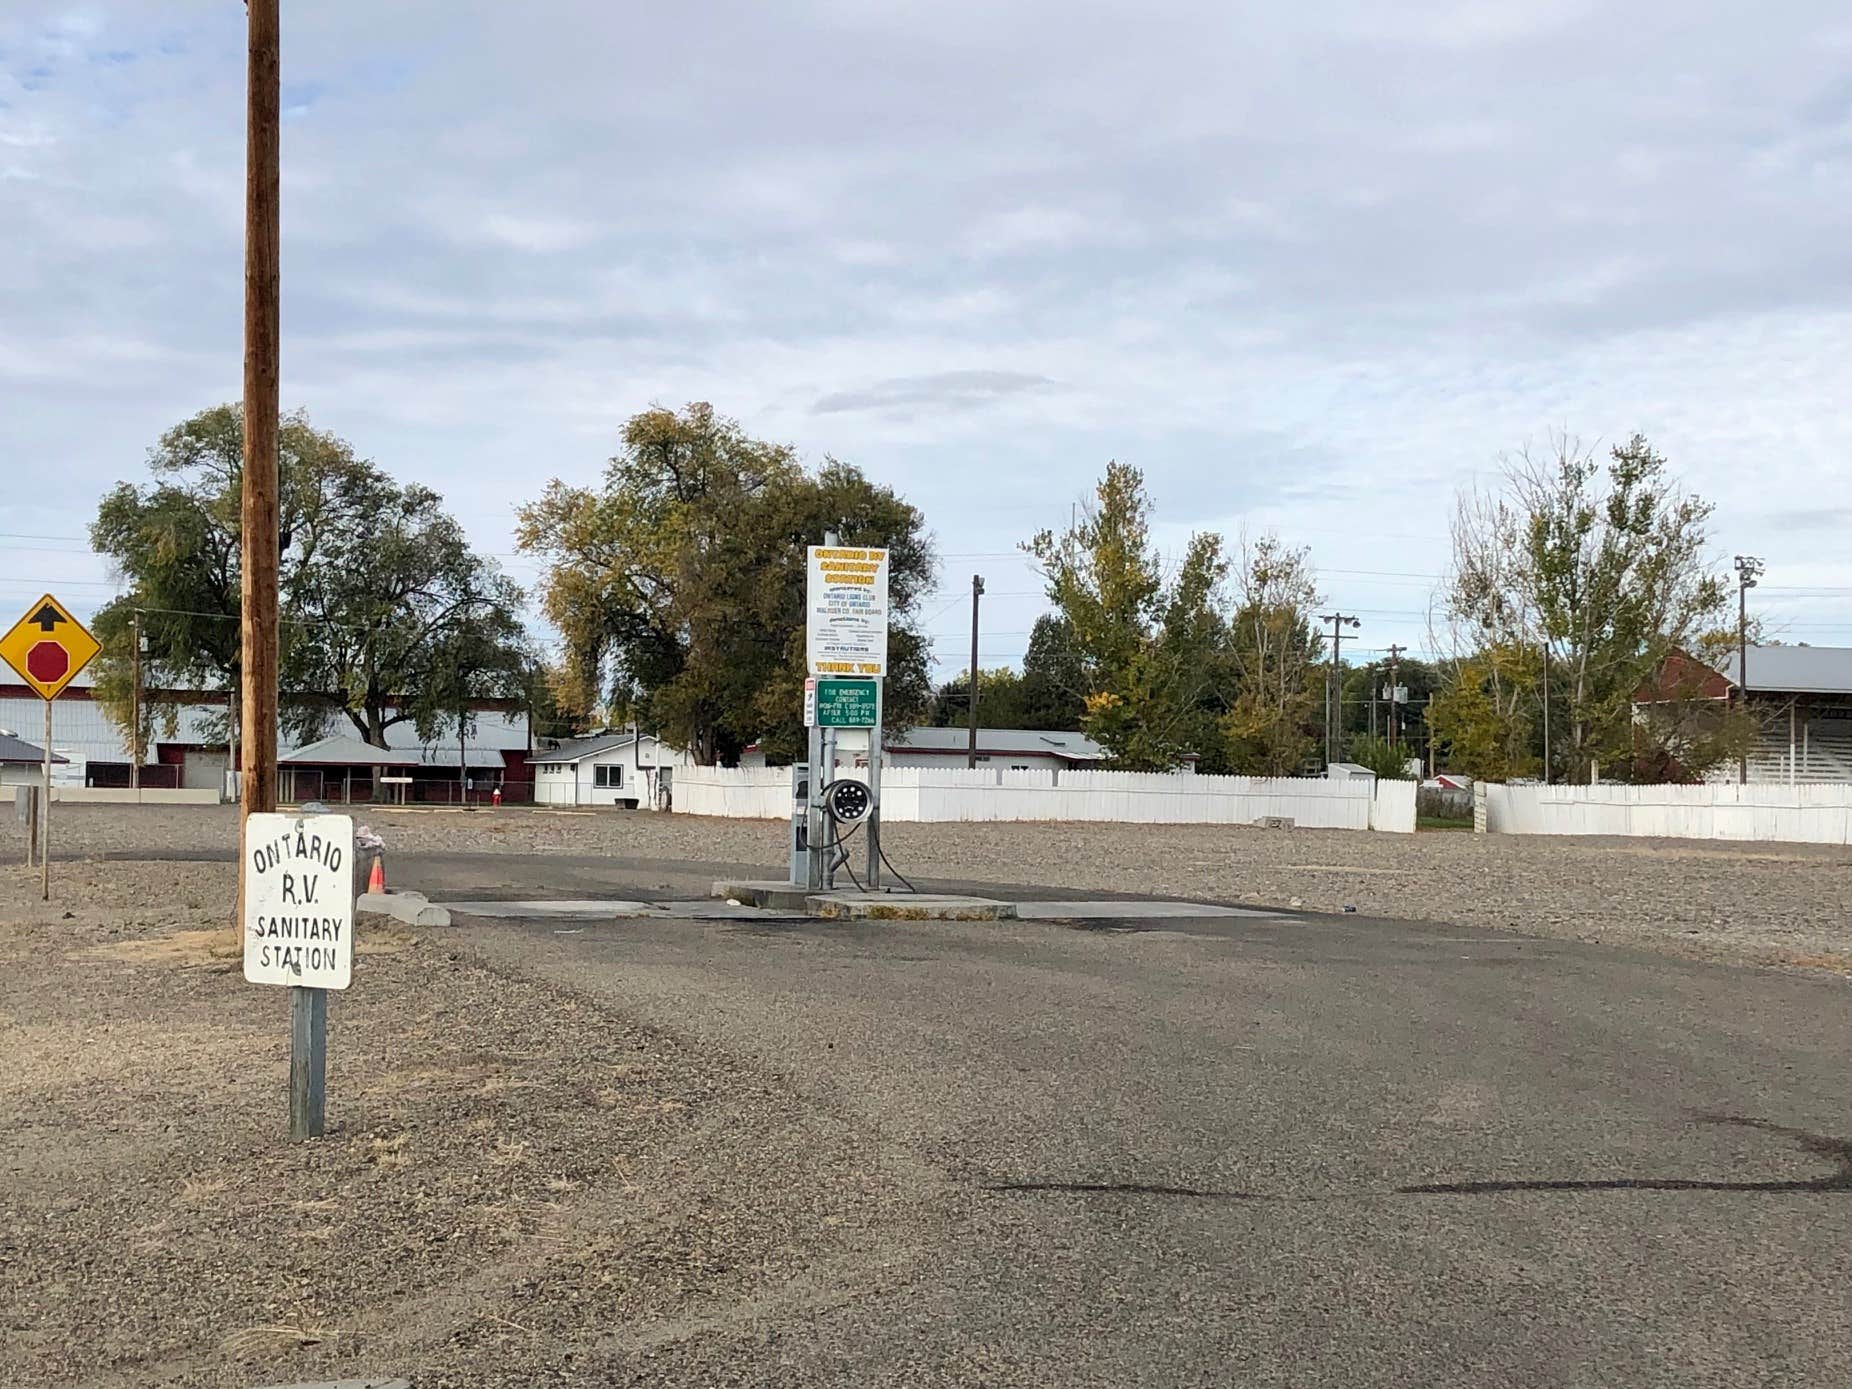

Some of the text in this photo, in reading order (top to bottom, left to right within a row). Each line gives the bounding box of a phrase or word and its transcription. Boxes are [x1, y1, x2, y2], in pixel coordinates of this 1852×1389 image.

[816, 662, 881, 673] THANK YOU
[254, 832, 342, 874] ONTARIO
[282, 874, 318, 906] R.V.
[256, 916, 342, 941] SANITARY
[260, 946, 336, 970] STATION
